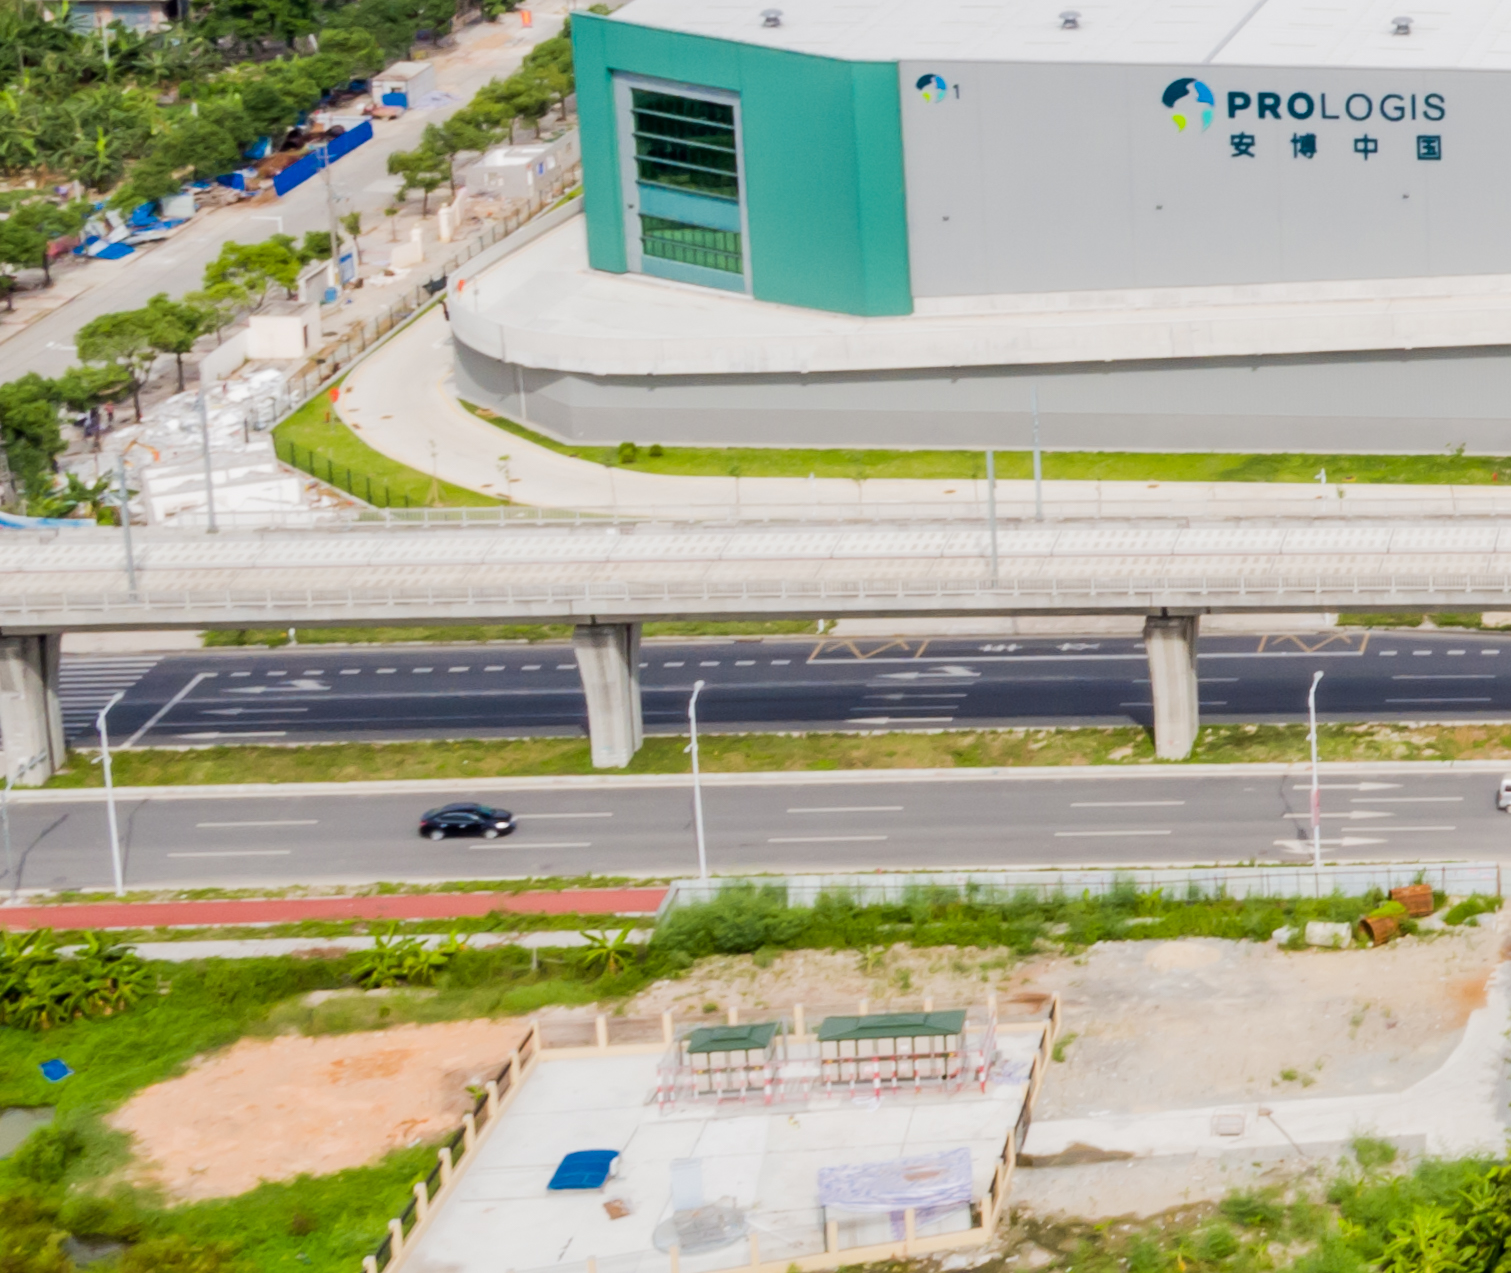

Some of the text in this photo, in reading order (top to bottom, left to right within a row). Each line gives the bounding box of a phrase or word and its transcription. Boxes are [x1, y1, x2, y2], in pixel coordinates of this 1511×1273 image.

[951, 83, 961, 100] 1
[1226, 90, 1446, 123] PROLOGIS
[1229, 131, 1442, 161] 安博中国
